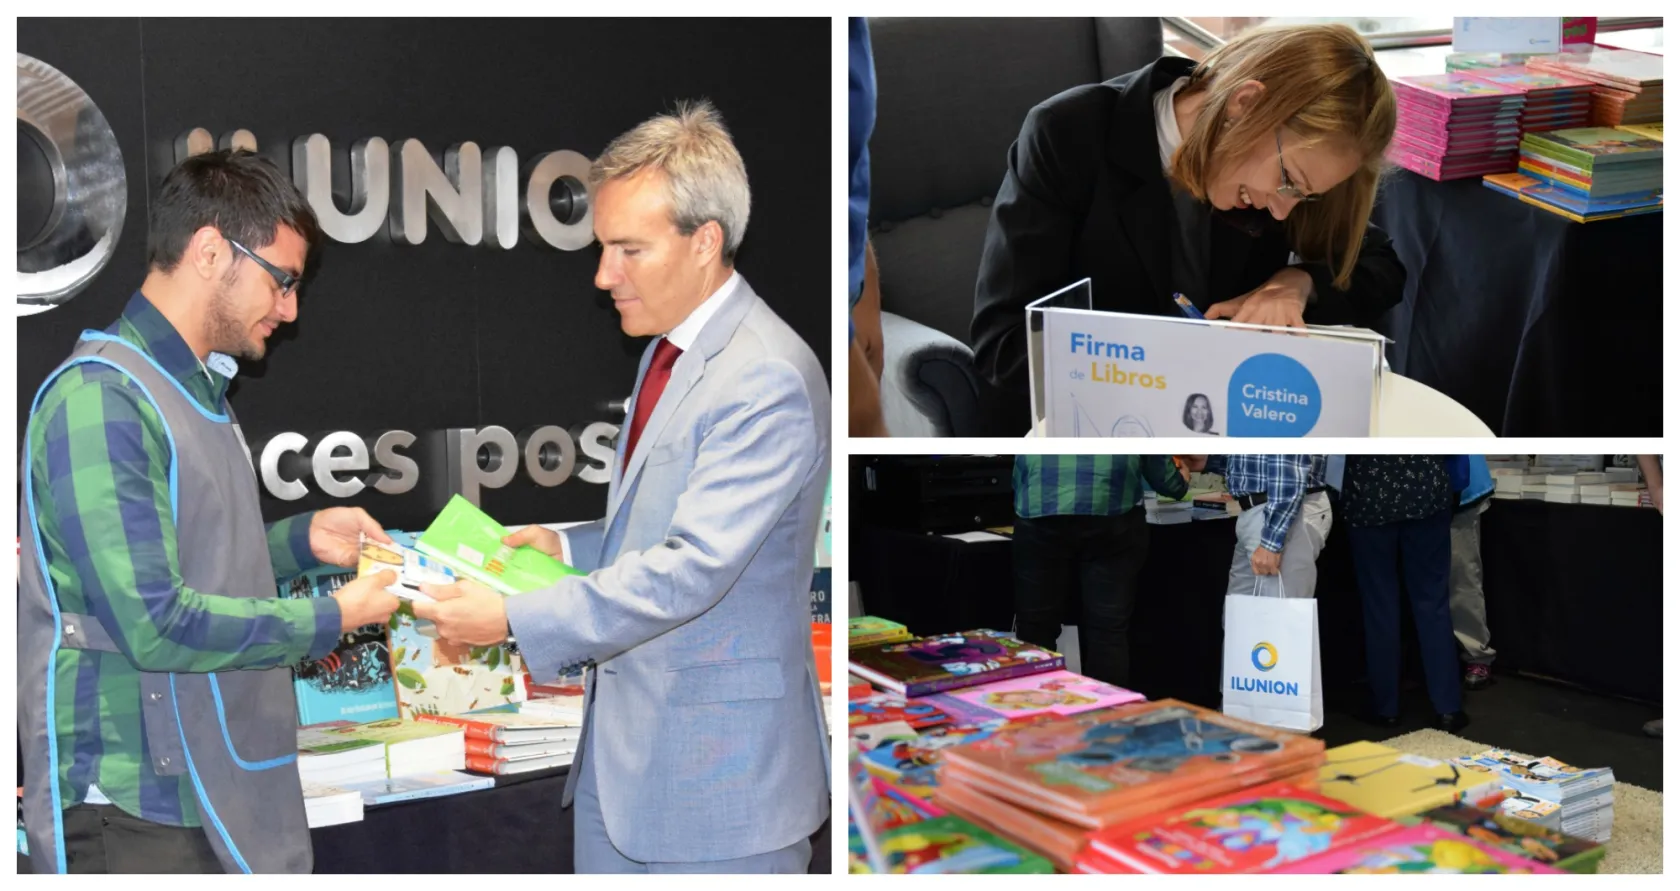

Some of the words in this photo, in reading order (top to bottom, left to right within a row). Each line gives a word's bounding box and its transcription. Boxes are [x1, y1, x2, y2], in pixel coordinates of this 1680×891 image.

[174, 127, 594, 251] UNIO
[1070, 332, 1145, 361] Firma
[1070, 369, 1085, 380] de
[1091, 361, 1167, 390] Libros
[1242, 383, 1308, 406] Cristina
[1241, 402, 1297, 423] Valero
[448, 397, 632, 510] pos
[1231, 676, 1299, 696] ILUNION
